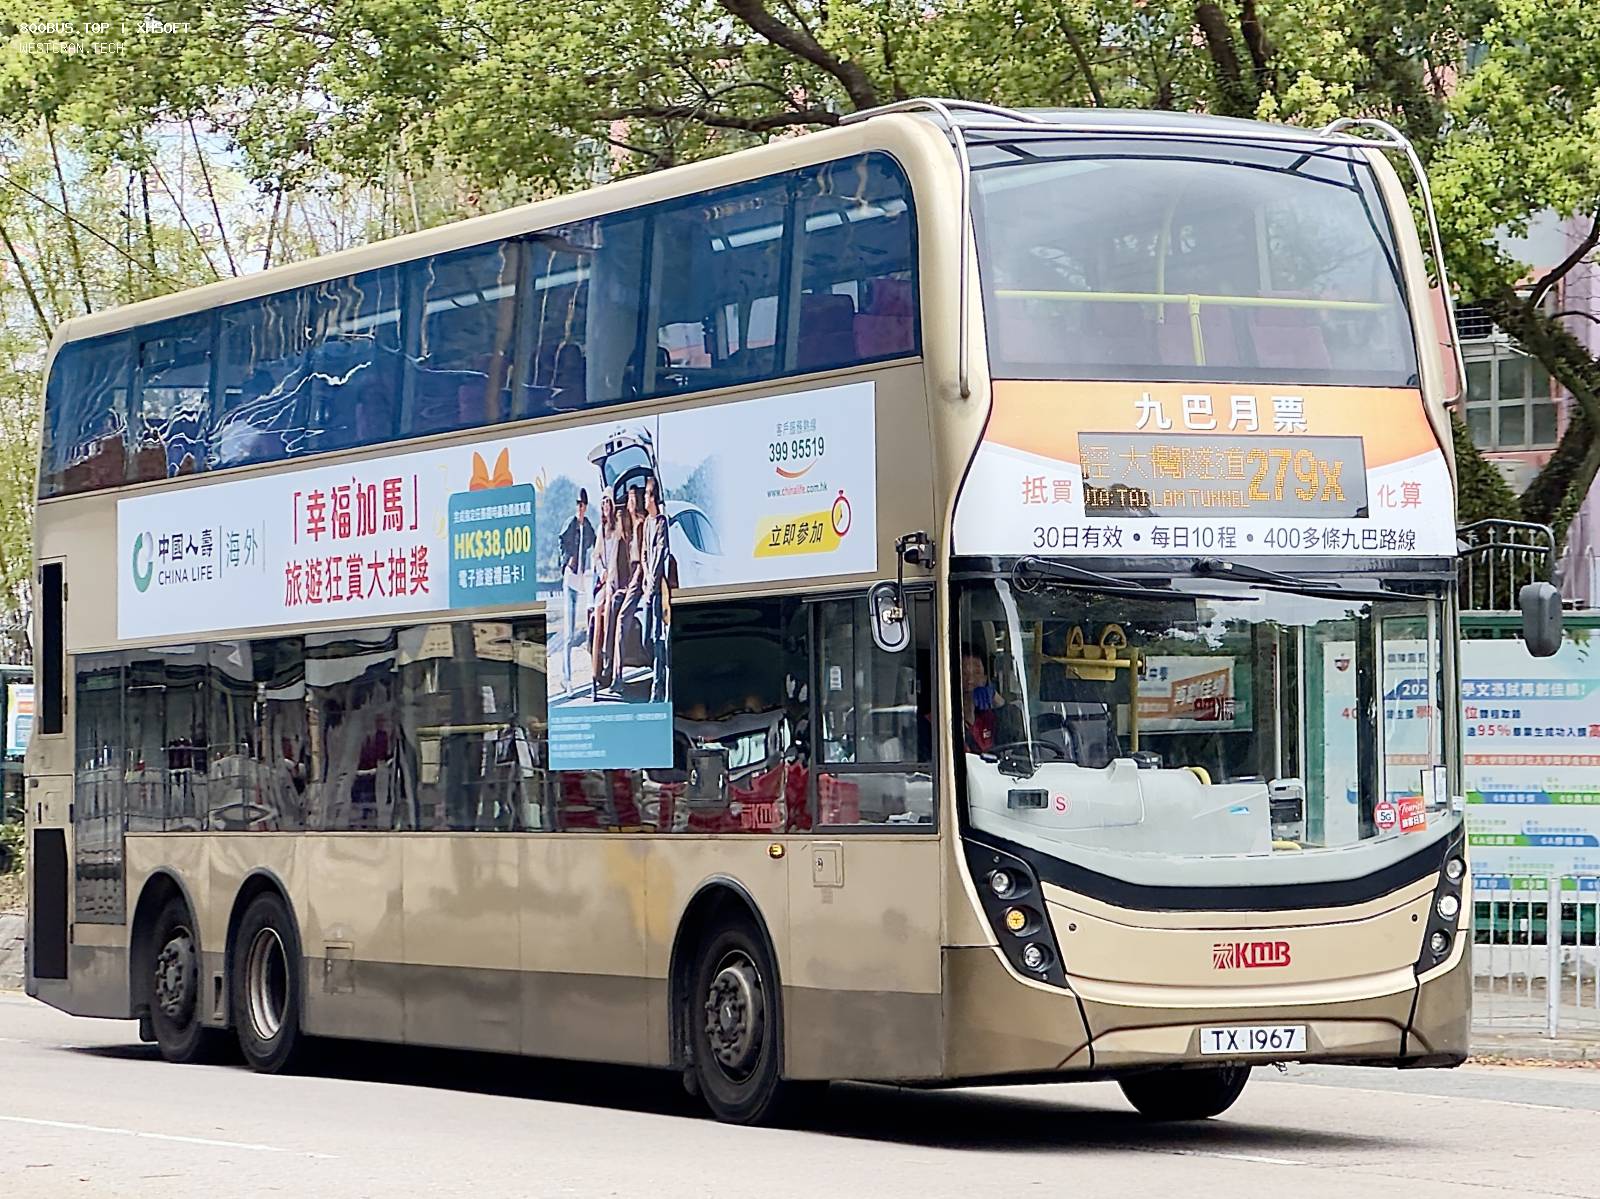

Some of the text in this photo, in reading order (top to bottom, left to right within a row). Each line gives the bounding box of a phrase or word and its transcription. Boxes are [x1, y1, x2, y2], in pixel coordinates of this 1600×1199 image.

[1135, 392, 1308, 434] 九巴月票
[769, 436, 825, 463] 399 95519
[767, 482, 828, 498] www.chinalife.com.hk
[1021, 475, 1073, 505] 抵買
[1117, 489, 1148, 507] TAI
[1153, 489, 1186, 507] LAM
[1190, 489, 1251, 508] TUNNEL
[1377, 479, 1423, 509] 化算
[453, 525, 531, 562] HK$38,000
[769, 520, 824, 547] 立即參加
[1033, 525, 1417, 552] 30日有效 每日10程 400多條九巴路線
[158, 528, 258, 568] 中國人壽 海外
[158, 564, 213, 586] CHINA LIFE
[284, 545, 430, 608] 旅遊狂賞大抽獎
[1402, 684, 1428, 696] 202
[1055, 796, 1066, 812] S
[1380, 811, 1392, 822] 5G
[1236, 941, 1291, 969] KMB
[1211, 1028, 1296, 1050] TX 1967
